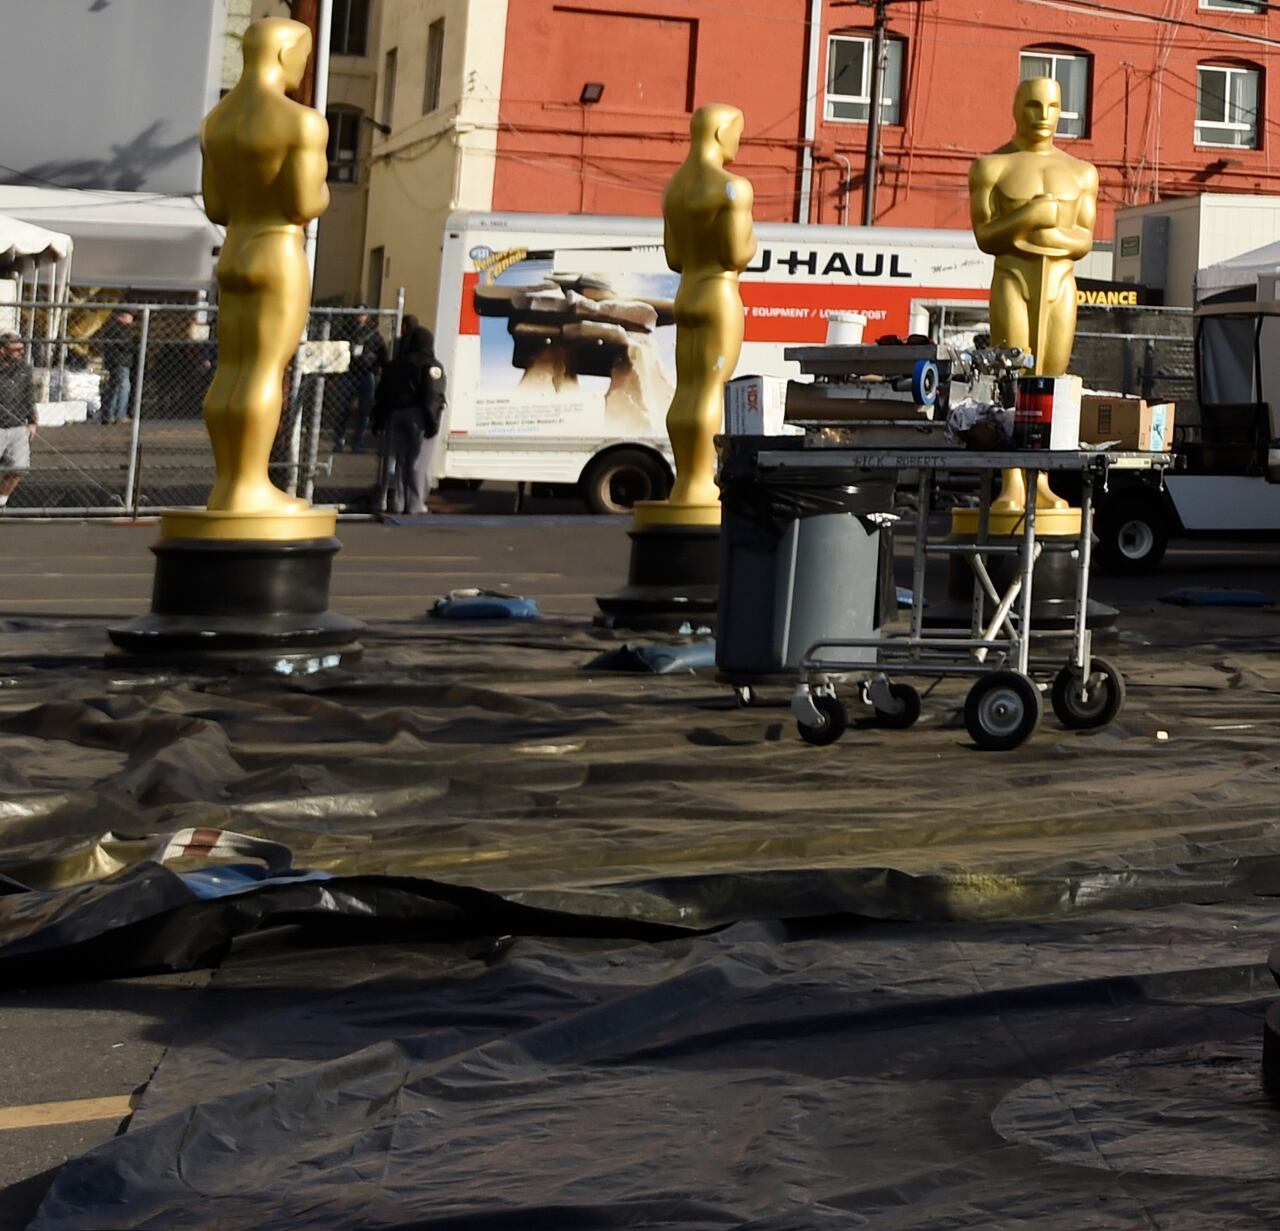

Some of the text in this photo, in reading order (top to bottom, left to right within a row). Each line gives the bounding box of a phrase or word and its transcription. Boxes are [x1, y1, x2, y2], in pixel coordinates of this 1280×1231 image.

[1076, 291, 1137, 305] DVANCE
[752, 307, 809, 318] EQUIPMENT
[861, 309, 887, 320] COST
